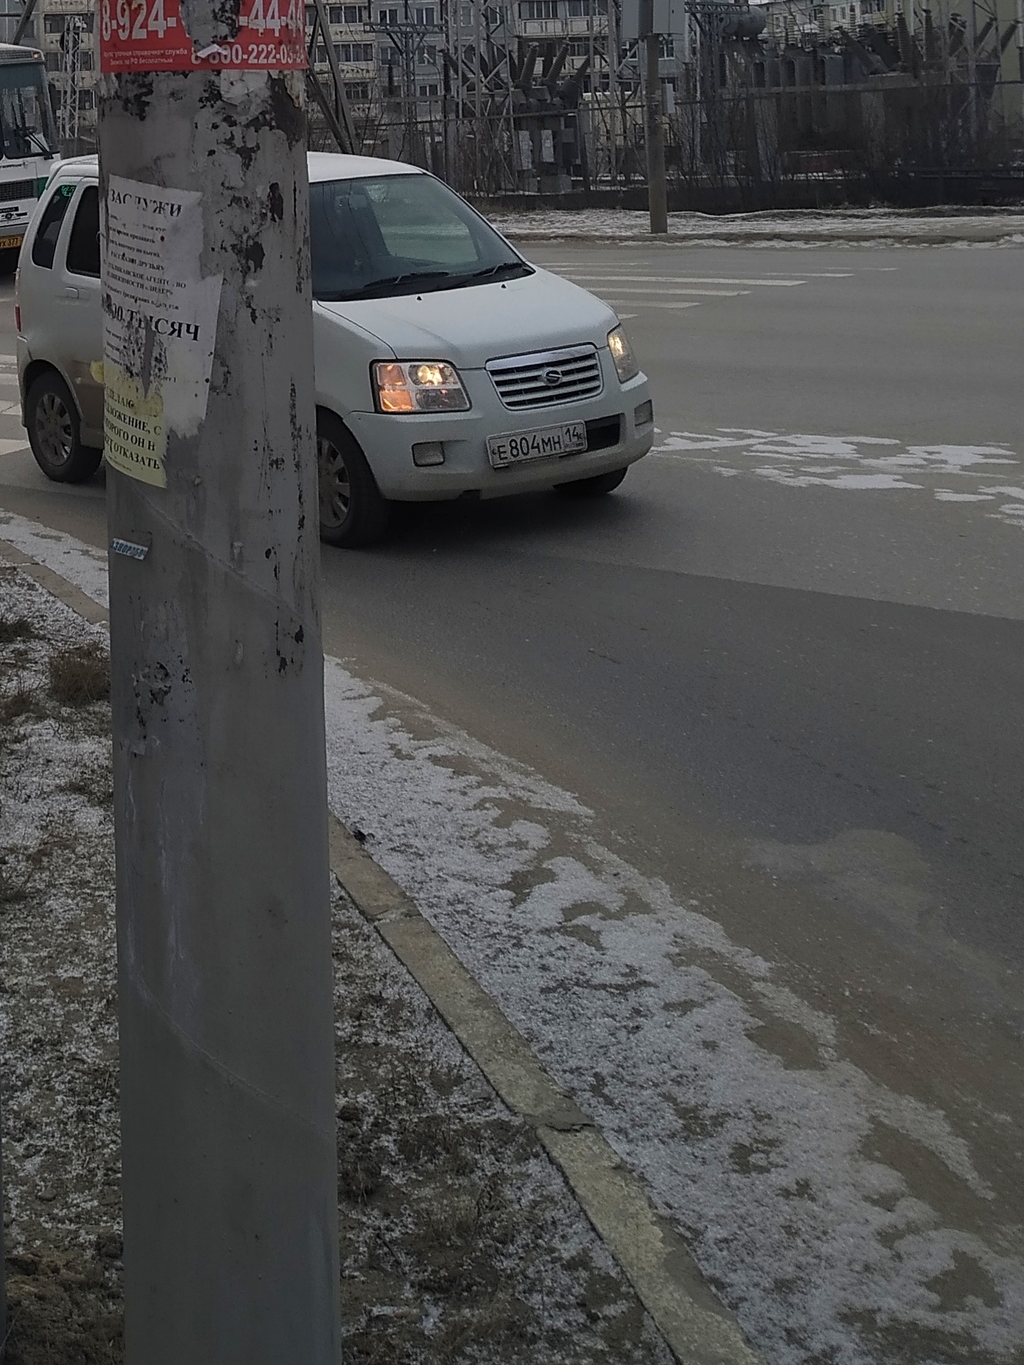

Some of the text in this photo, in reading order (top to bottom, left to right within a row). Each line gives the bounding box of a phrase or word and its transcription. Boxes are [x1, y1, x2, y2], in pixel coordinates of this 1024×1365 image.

[164, 47, 188, 57] служба
[130, 434, 145, 449] ОН
[497, 433, 562, 461] Е804МН
[113, 442, 161, 471] ОТКАЗАТЬ
